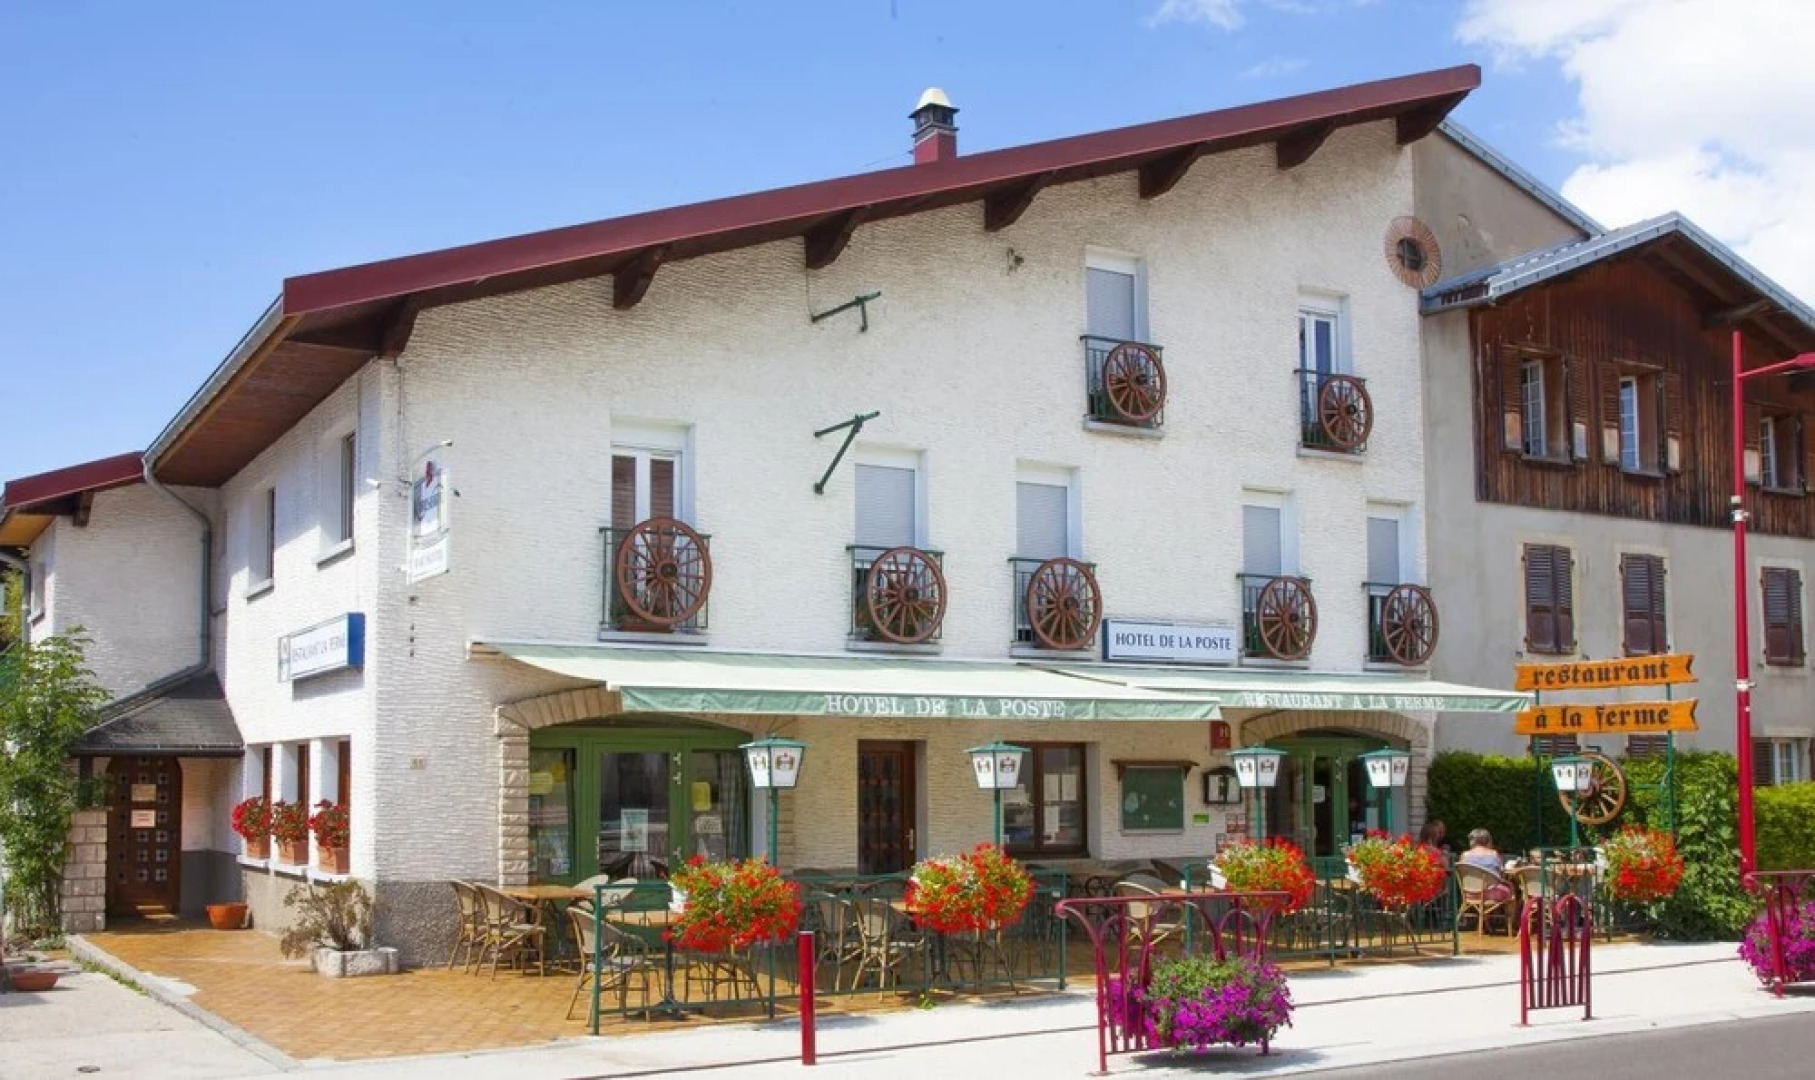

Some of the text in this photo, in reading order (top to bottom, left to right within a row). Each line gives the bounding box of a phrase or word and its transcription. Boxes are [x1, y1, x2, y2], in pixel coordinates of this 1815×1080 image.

[1115, 632, 1232, 650] HOTEL DE LA POSTE
[1532, 660, 1669, 686] restaurant
[825, 694, 1067, 718] HOTEL DE LA POSTE
[1244, 691, 1343, 709] RESTAURANT
[1369, 695, 1389, 710] LA
[1395, 696, 1446, 711] FERME
[1535, 705, 1670, 731] à la ferme
